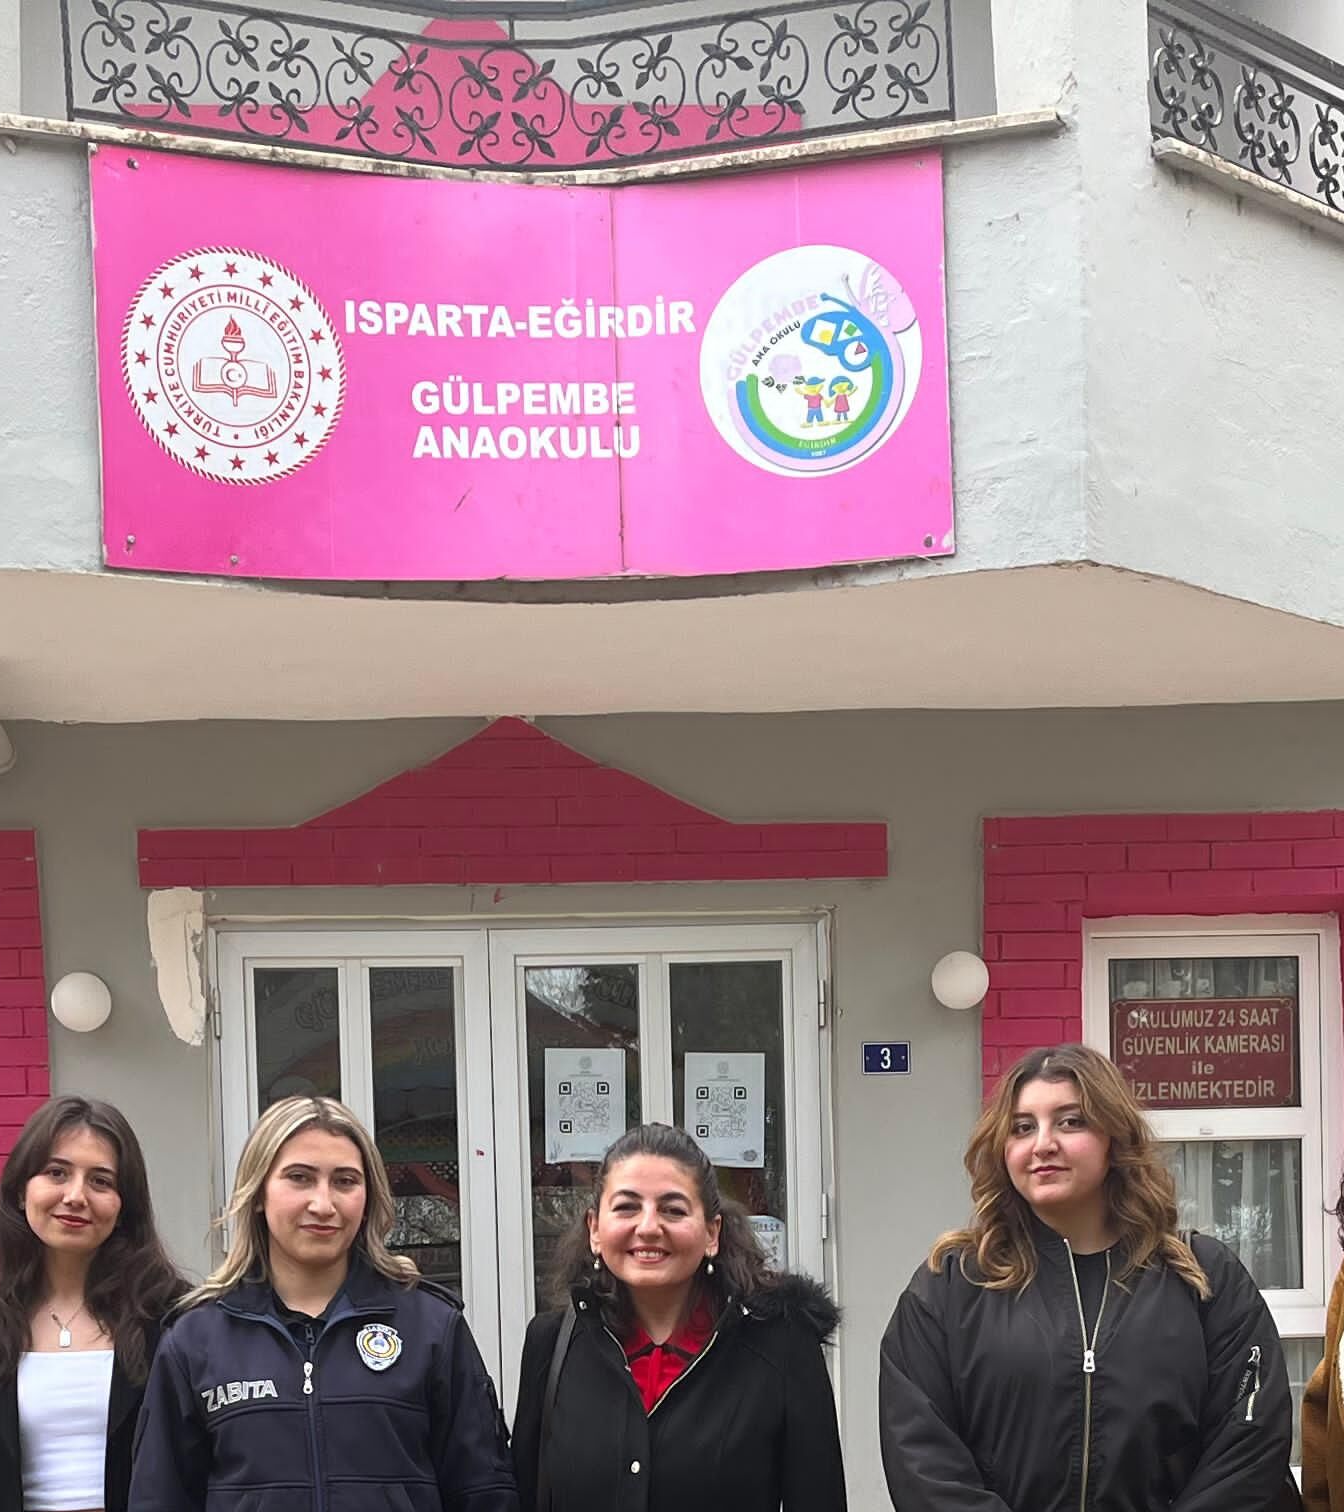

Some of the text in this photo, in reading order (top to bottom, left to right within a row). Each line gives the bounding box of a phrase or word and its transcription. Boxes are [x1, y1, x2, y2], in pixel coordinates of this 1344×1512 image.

[162, 289, 223, 377] CUMHURİYETİ
[344, 296, 697, 339] ISPARTA-EĞİRDİR
[769, 320, 802, 345] OKULU
[269, 311, 305, 365] EĞİTİM
[167, 381, 222, 438] TÜRKİYE
[254, 370, 306, 440] BAKANLIĞI
[411, 375, 637, 416] GÜLPEMBE
[412, 425, 641, 460] ANAOKULU
[1127, 1008, 1280, 1030] OKULUMUZ 24 SAAT
[880, 1047, 891, 1069] 3
[1122, 1031, 1285, 1056] GÜVENLİK KAMERASI
[1191, 1061, 1215, 1076] ile
[1131, 1075, 1275, 1101] İZLENMEKTEDİR
[201, 1379, 279, 1413] ZABITA
